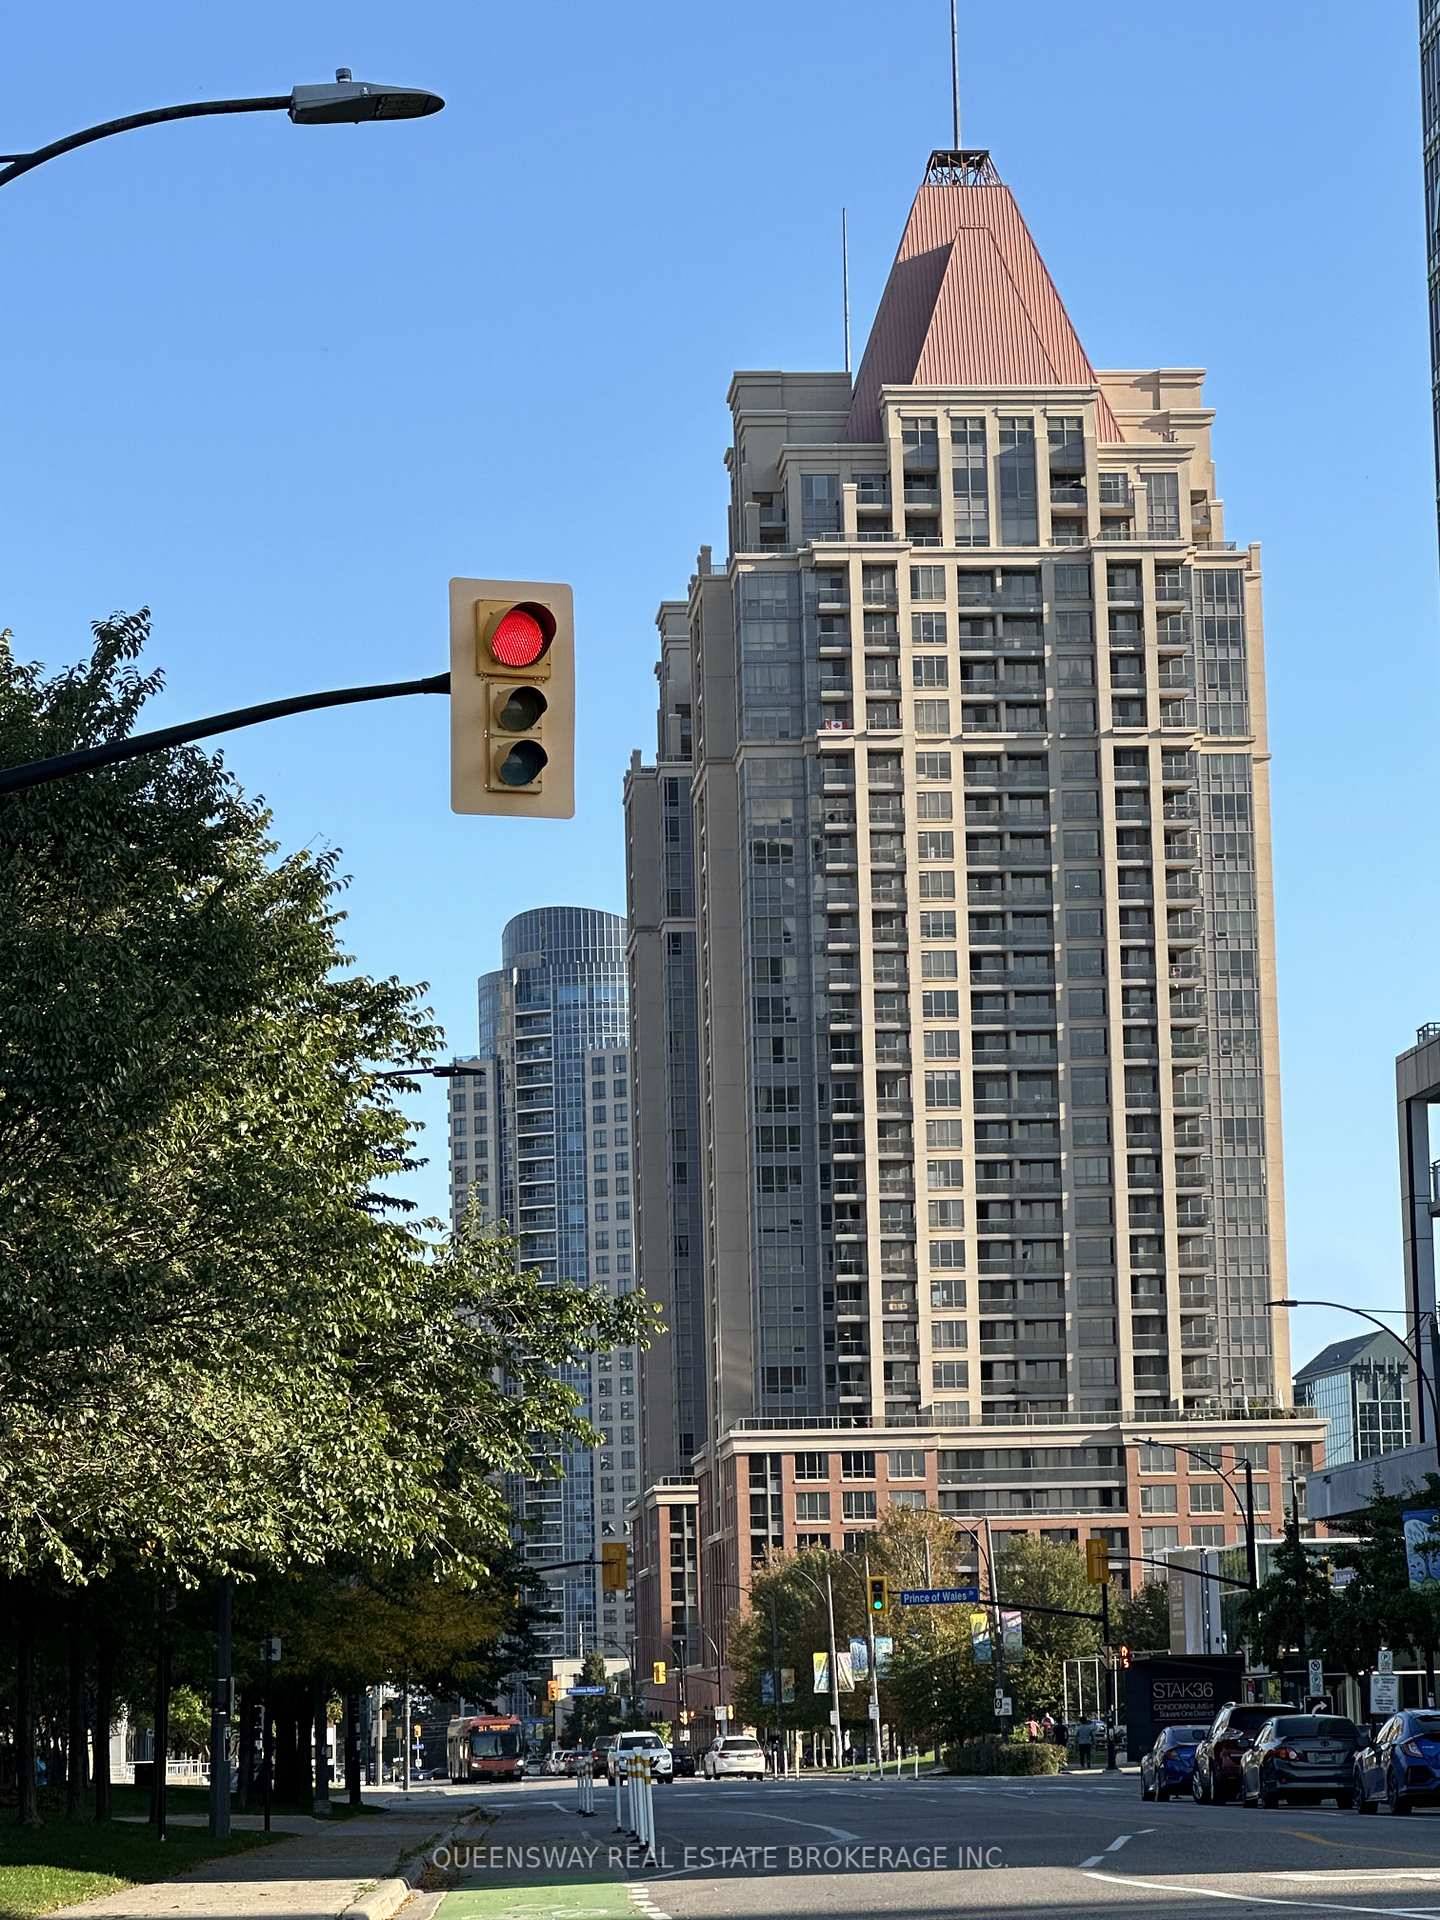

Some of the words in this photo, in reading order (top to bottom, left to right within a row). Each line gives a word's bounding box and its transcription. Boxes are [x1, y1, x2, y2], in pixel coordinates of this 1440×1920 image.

[903, 1593, 930, 1603] Prince
[931, 1592, 940, 1602] of
[942, 1591, 967, 1602] Wales
[1152, 1681, 1214, 1699] STAK36
